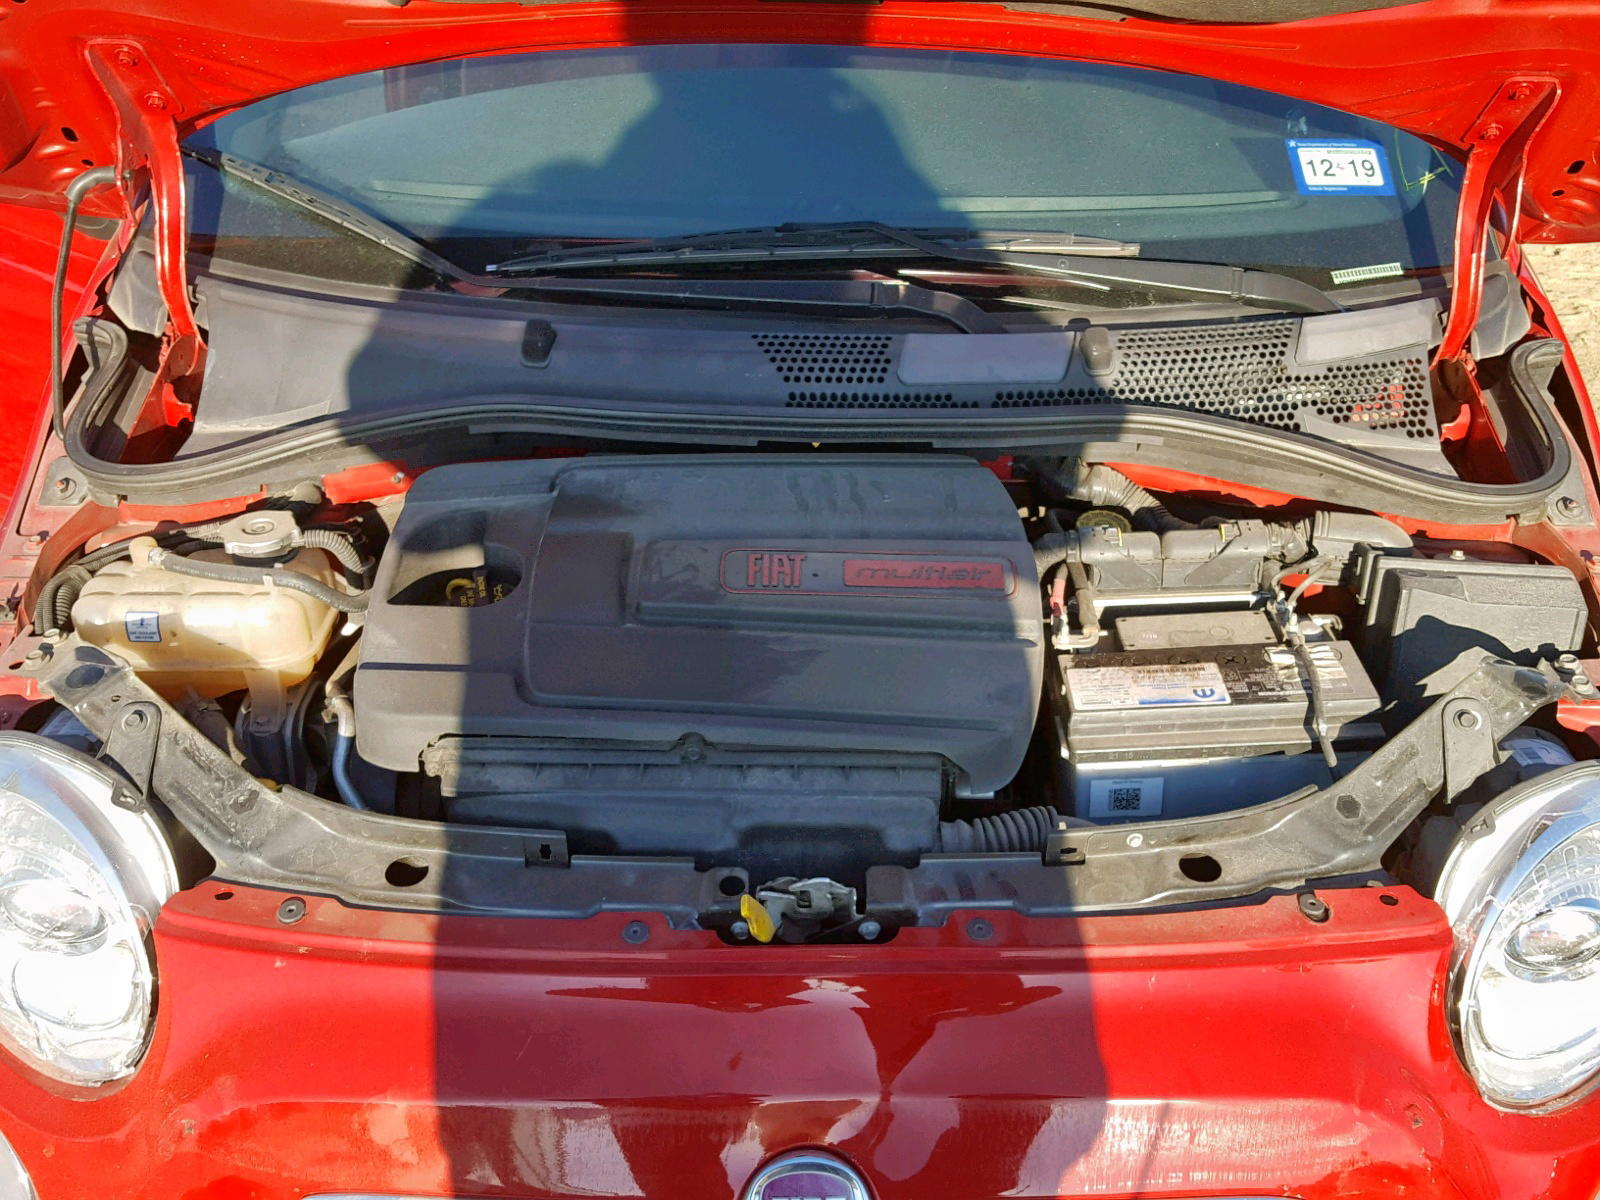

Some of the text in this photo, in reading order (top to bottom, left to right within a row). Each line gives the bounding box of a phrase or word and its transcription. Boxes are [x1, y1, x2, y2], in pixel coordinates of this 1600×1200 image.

[1306, 158, 1376, 178] 12 19
[746, 552, 808, 587] FIAT
